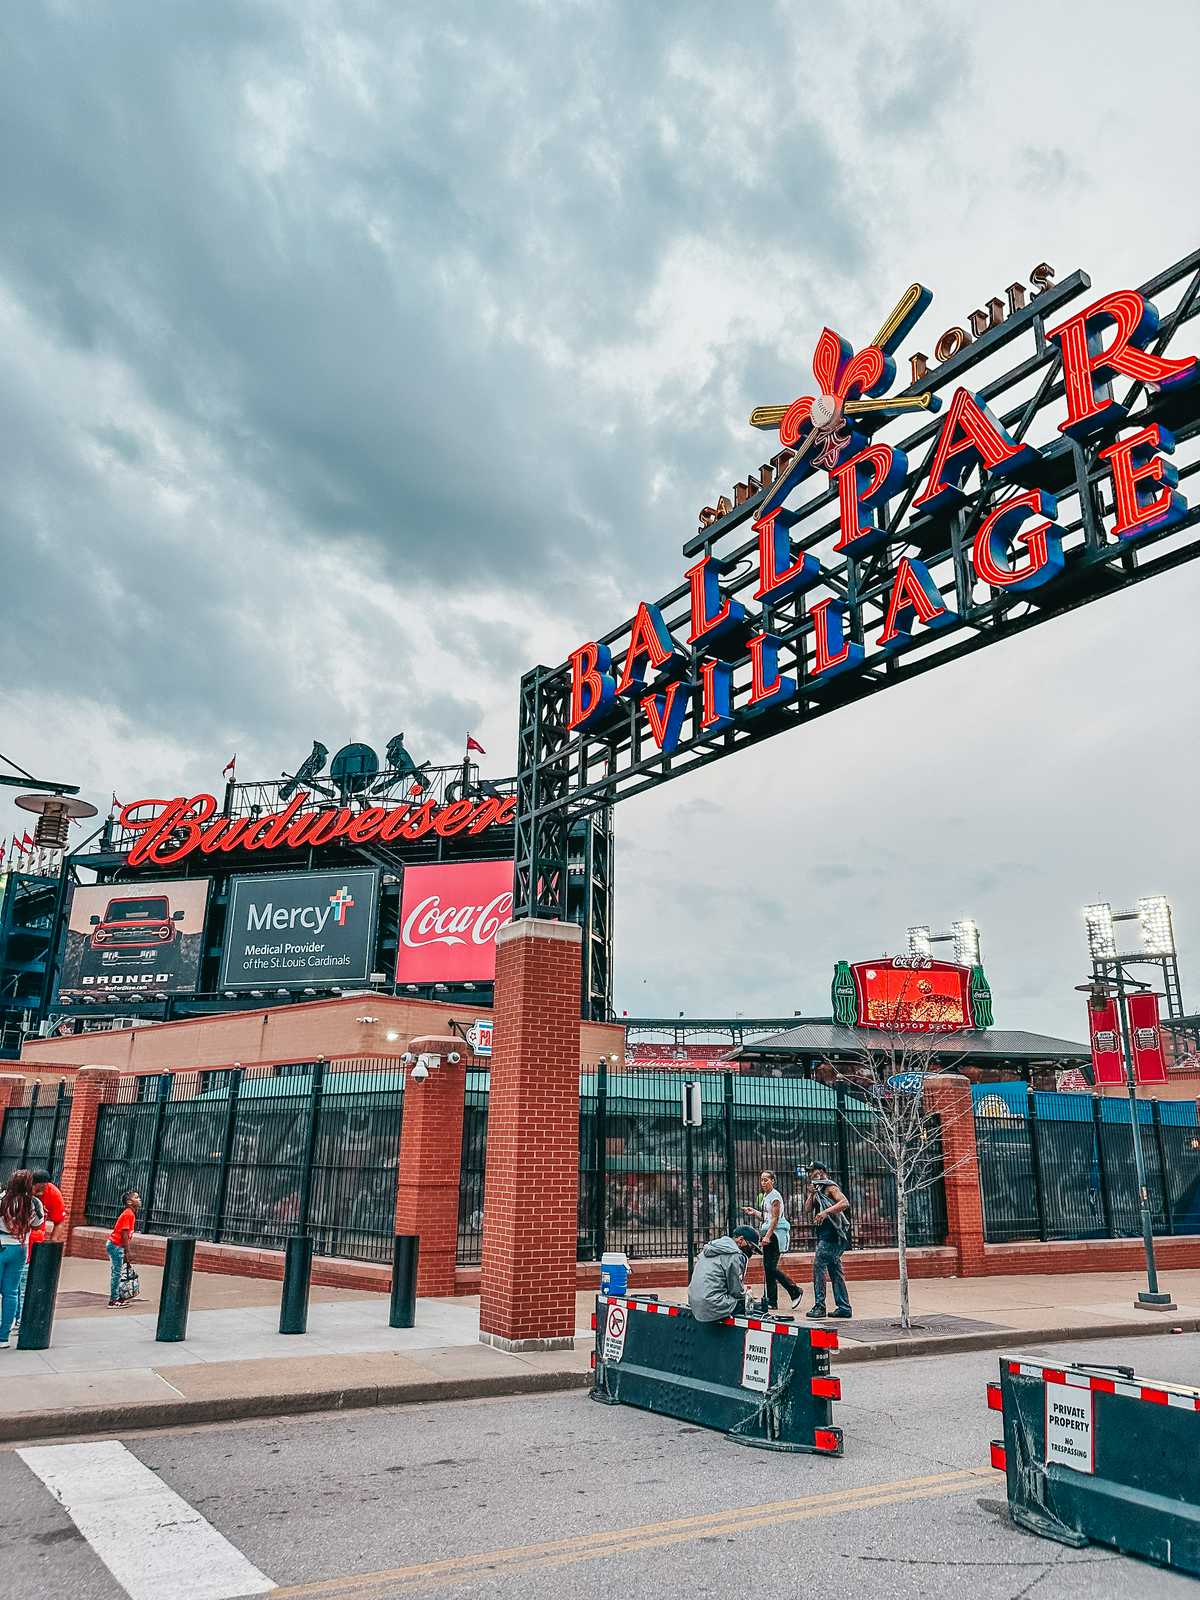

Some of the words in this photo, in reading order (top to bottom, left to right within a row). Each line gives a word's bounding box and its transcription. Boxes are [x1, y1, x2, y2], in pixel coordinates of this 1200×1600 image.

[909, 262, 1055, 384] LOUIS
[640, 422, 1187, 751] VILLAGE
[119, 784, 518, 866] Budweiser
[247, 902, 332, 934] Mercy
[245, 943, 283, 956] Medical
[284, 941, 325, 954] Provider
[243, 958, 254, 970] of
[254, 957, 269, 969] the
[307, 954, 351, 967] Cardinals
[82, 974, 169, 985] BRONCO
[749, 1344, 767, 1355] PRIVATE
[745, 1353, 769, 1365] PROPERTY
[1053, 1403, 1085, 1419] PRIVATE
[1049, 1414, 1090, 1432] PROPERTY
[1064, 1437, 1074, 1446] NO
[1051, 1443, 1087, 1458] TRESPASSING
